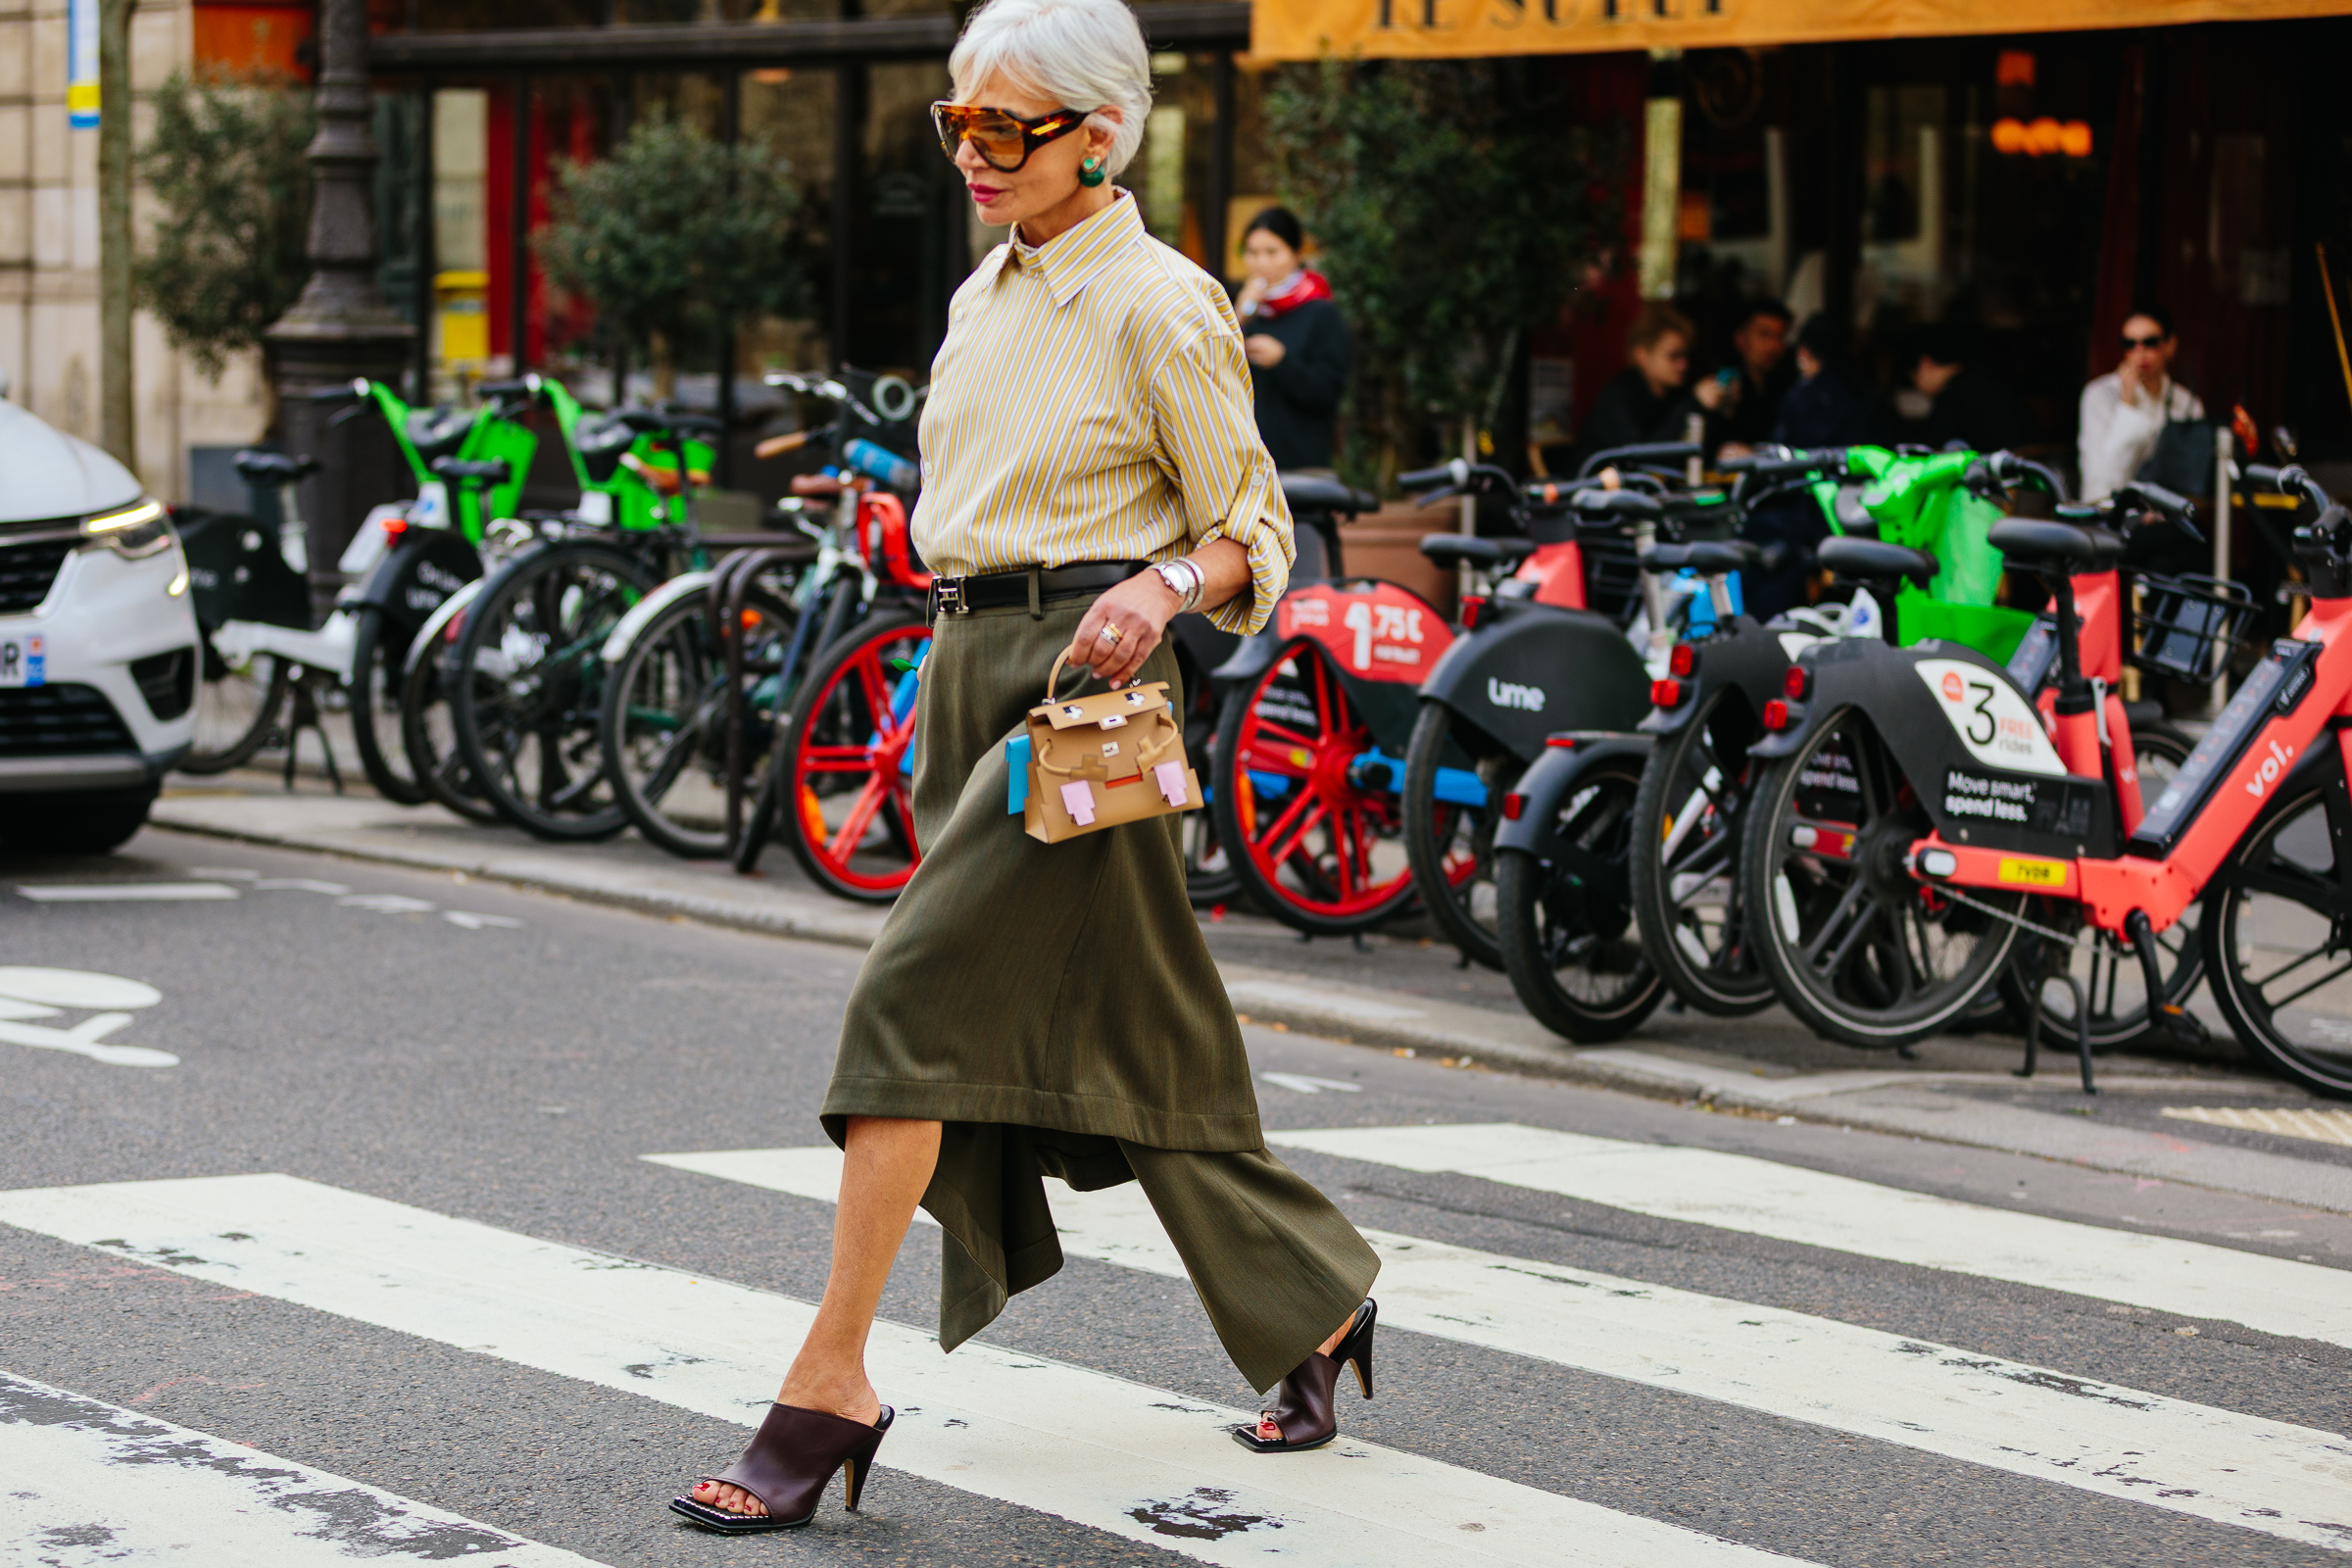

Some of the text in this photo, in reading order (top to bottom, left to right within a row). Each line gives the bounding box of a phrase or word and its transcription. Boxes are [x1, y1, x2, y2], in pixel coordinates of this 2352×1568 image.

[1967, 681, 1995, 746] 3
[2000, 717, 2034, 740] FREE
[1948, 771, 2035, 804] Move smart,
[1944, 795, 2029, 822] spend less.
